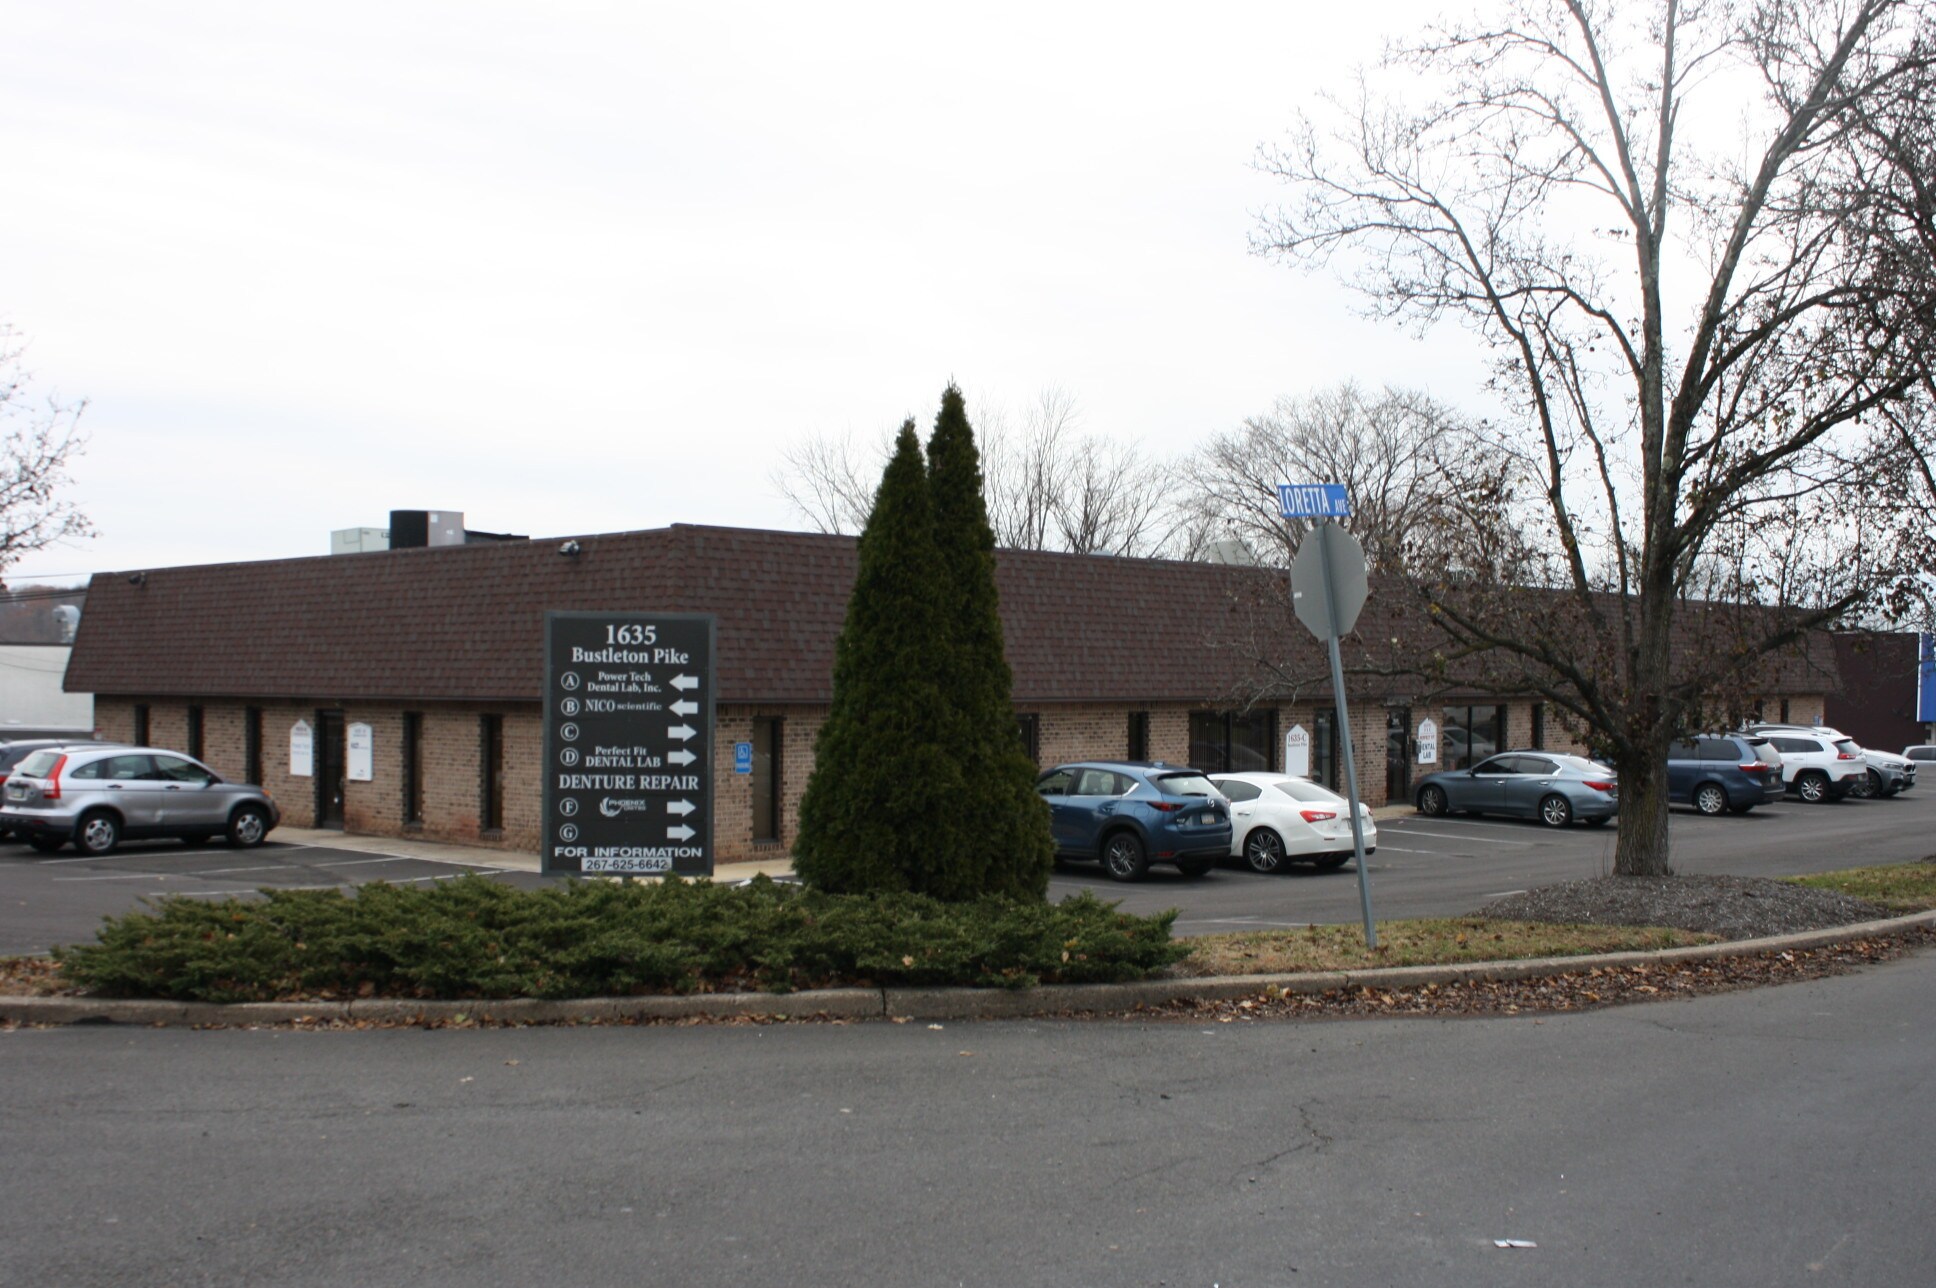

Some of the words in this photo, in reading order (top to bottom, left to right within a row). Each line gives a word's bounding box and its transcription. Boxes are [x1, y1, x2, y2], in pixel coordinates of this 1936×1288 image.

[1279, 487, 1330, 514] LORETTA
[1335, 499, 1347, 514] AVE
[606, 624, 657, 645] 1635
[572, 647, 649, 664] Bustleton
[653, 648, 689, 664] Pike
[564, 675, 576, 687] A
[598, 671, 627, 682] Power
[629, 671, 651, 682] Tech
[587, 682, 619, 692] Dental
[621, 683, 641, 693] Lab,
[644, 683, 662, 693] Inc.
[566, 701, 575, 713] B
[585, 699, 615, 712] NICO
[617, 702, 662, 711] scientific
[564, 726, 575, 738] C
[565, 750, 576, 762] D
[595, 746, 631, 756] Perfect
[633, 746, 647, 756] Fit
[585, 756, 634, 768] DENTAL
[637, 757, 661, 768] LAB
[558, 774, 635, 790] DENTURE
[639, 775, 699, 790] REPAIR
[565, 801, 574, 813] F
[563, 827, 574, 839] G
[554, 847, 588, 858] FOR
[594, 847, 702, 858] INFORMATION
[586, 859, 667, 870] 267-625-6642
